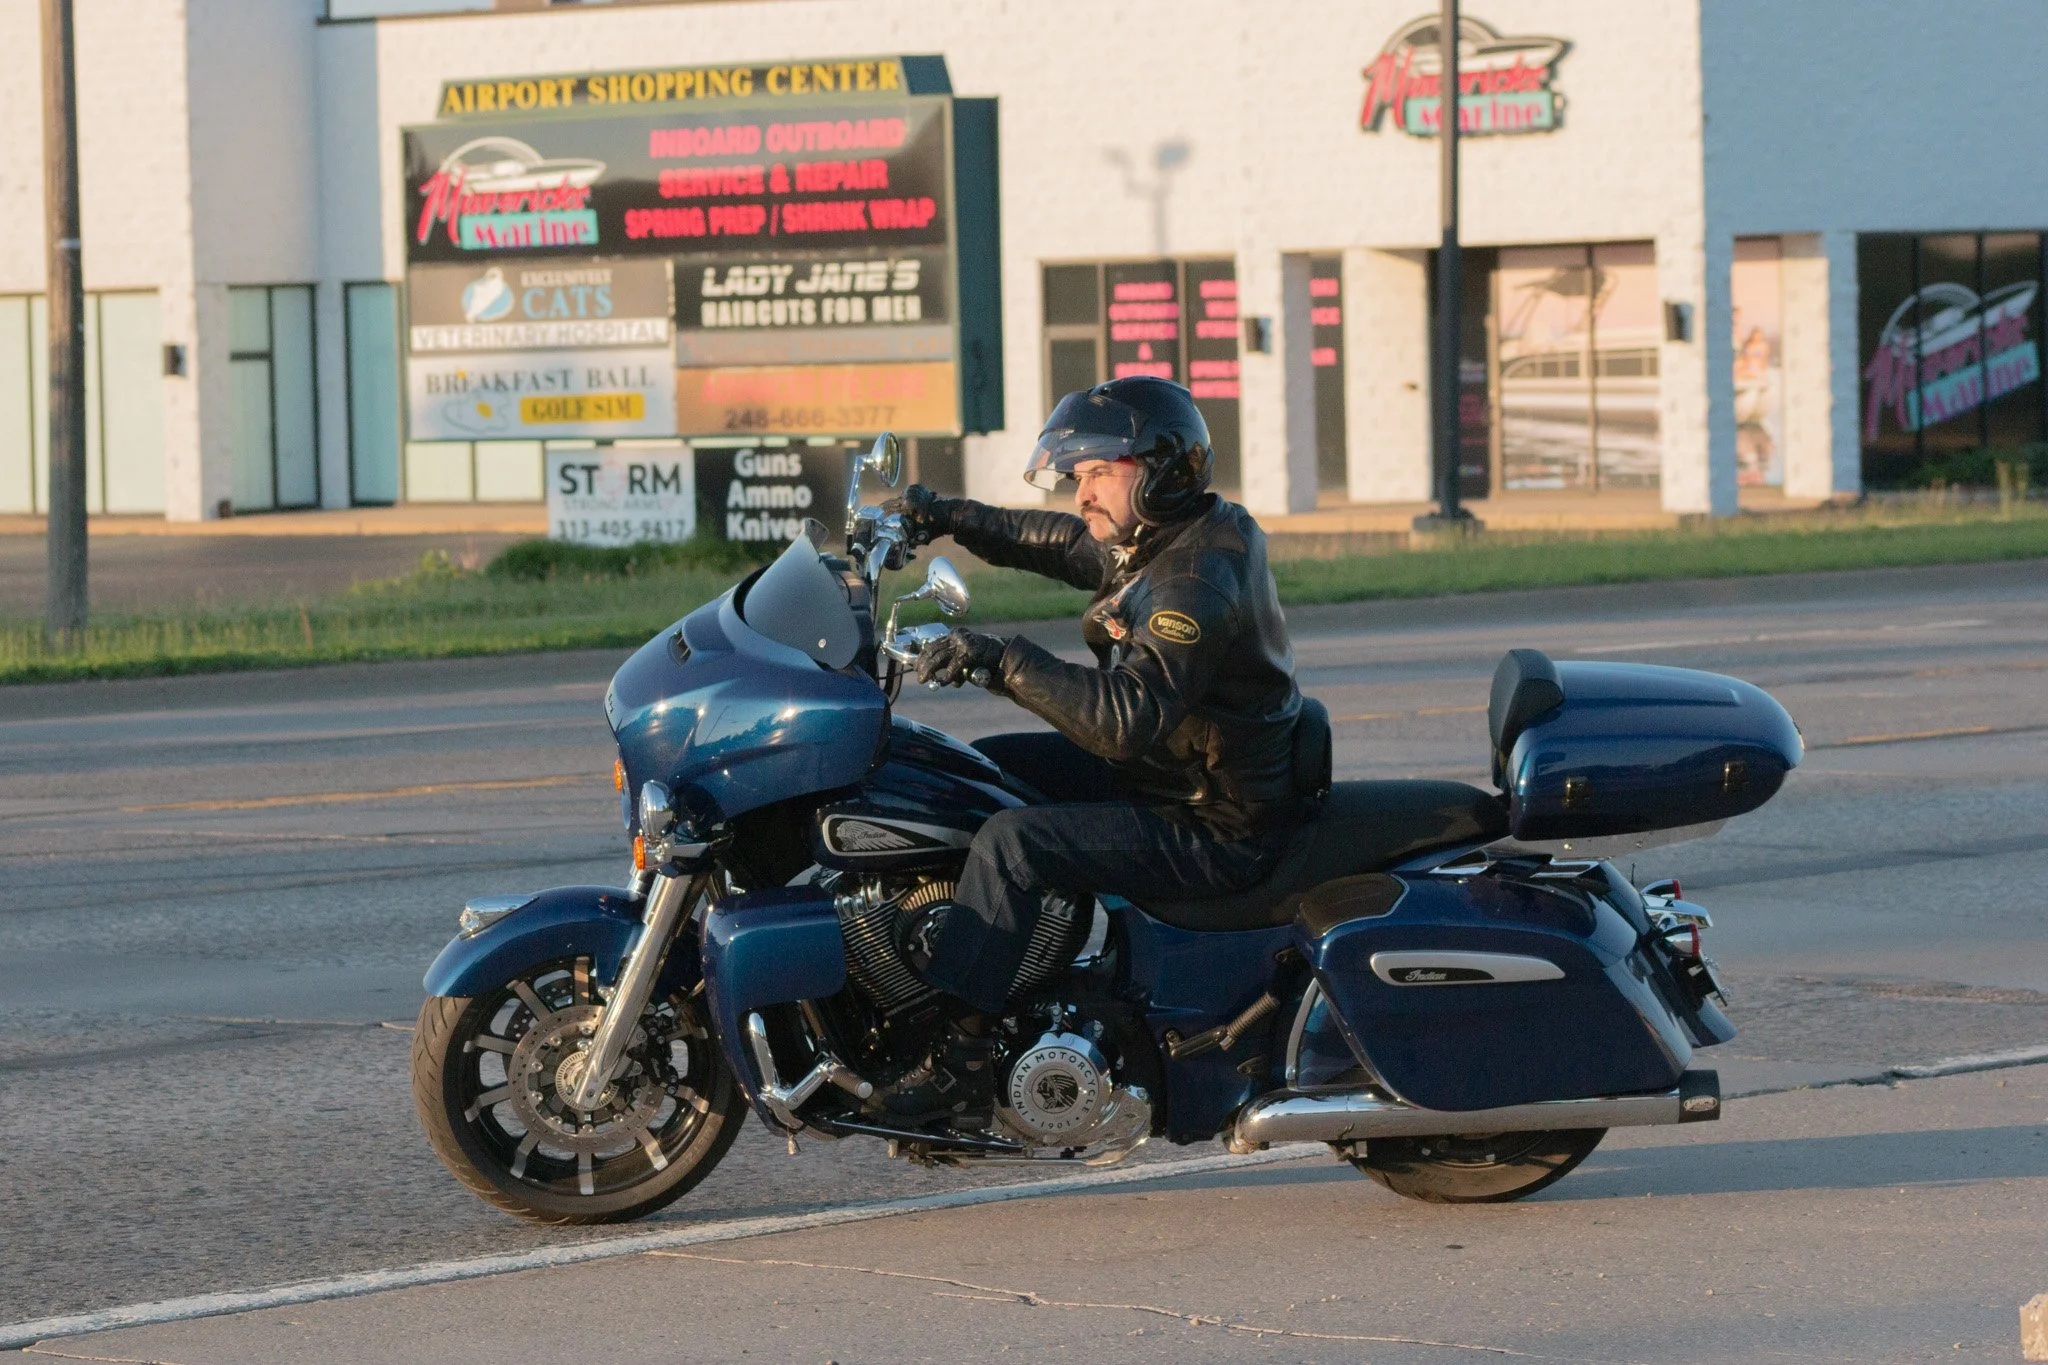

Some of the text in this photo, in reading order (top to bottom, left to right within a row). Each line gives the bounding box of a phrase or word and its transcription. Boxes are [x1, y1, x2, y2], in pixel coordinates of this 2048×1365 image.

[444, 60, 899, 114] AIRPORT SHOPPING CENTER
[649, 118, 905, 158] INBOARD OUTBOARD
[658, 159, 888, 198] SERVICE & REPAIR
[624, 207, 706, 239] SPRING
[708, 204, 766, 235] PREP
[782, 200, 868, 233] SHRINK
[868, 196, 936, 230] WRAP
[701, 260, 921, 296] LADY JANE'S
[521, 285, 614, 319] CATS
[701, 294, 921, 327] HAIRCUTS FOR MEN
[415, 318, 667, 349] VETERINARY HOSPITAL
[426, 366, 656, 395] BREAKFAST BALL
[532, 397, 589, 420] GOLF
[734, 448, 802, 477] Guns
[727, 480, 812, 508] Ammo
[727, 511, 804, 541] Knive
[1012, 1051, 1098, 1116] INDIAN MOTORCYCLE
[1041, 1120, 1071, 1130] 1901
